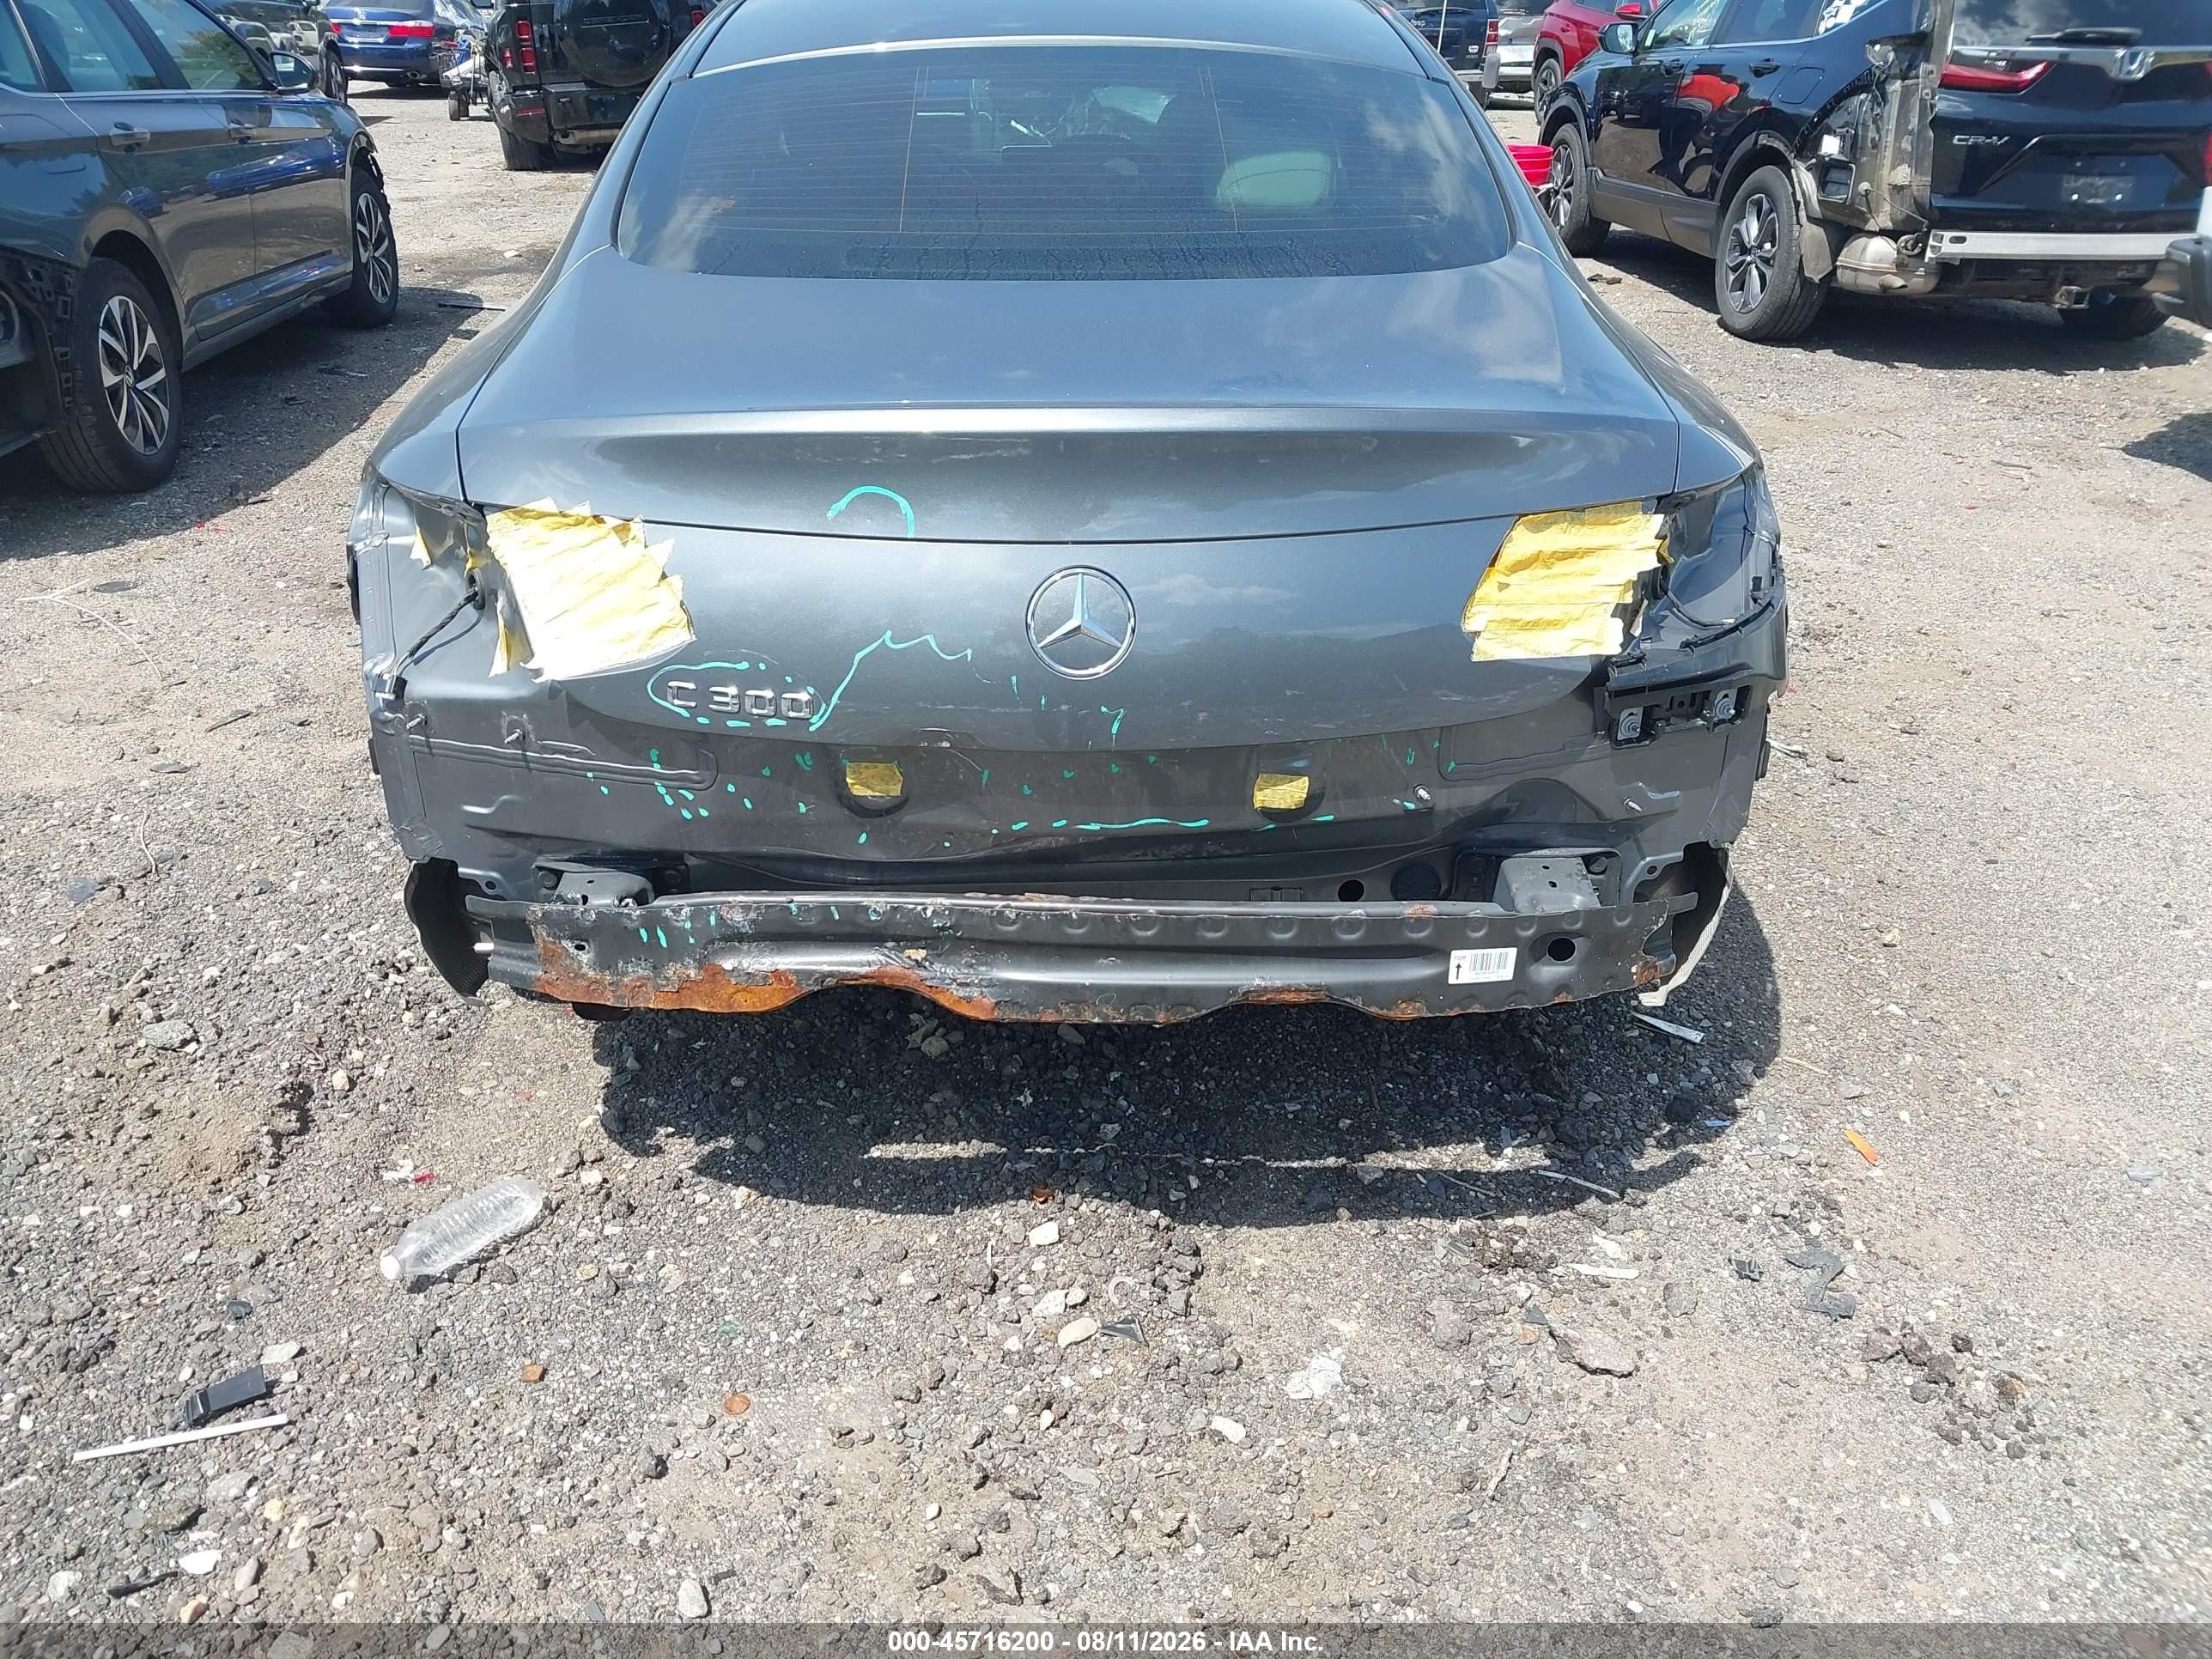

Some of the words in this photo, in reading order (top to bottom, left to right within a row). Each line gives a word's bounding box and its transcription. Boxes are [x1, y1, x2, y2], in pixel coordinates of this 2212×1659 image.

[1953, 135, 2010, 145] CR-V
[666, 680, 697, 708] C
[708, 685, 814, 720] 300
